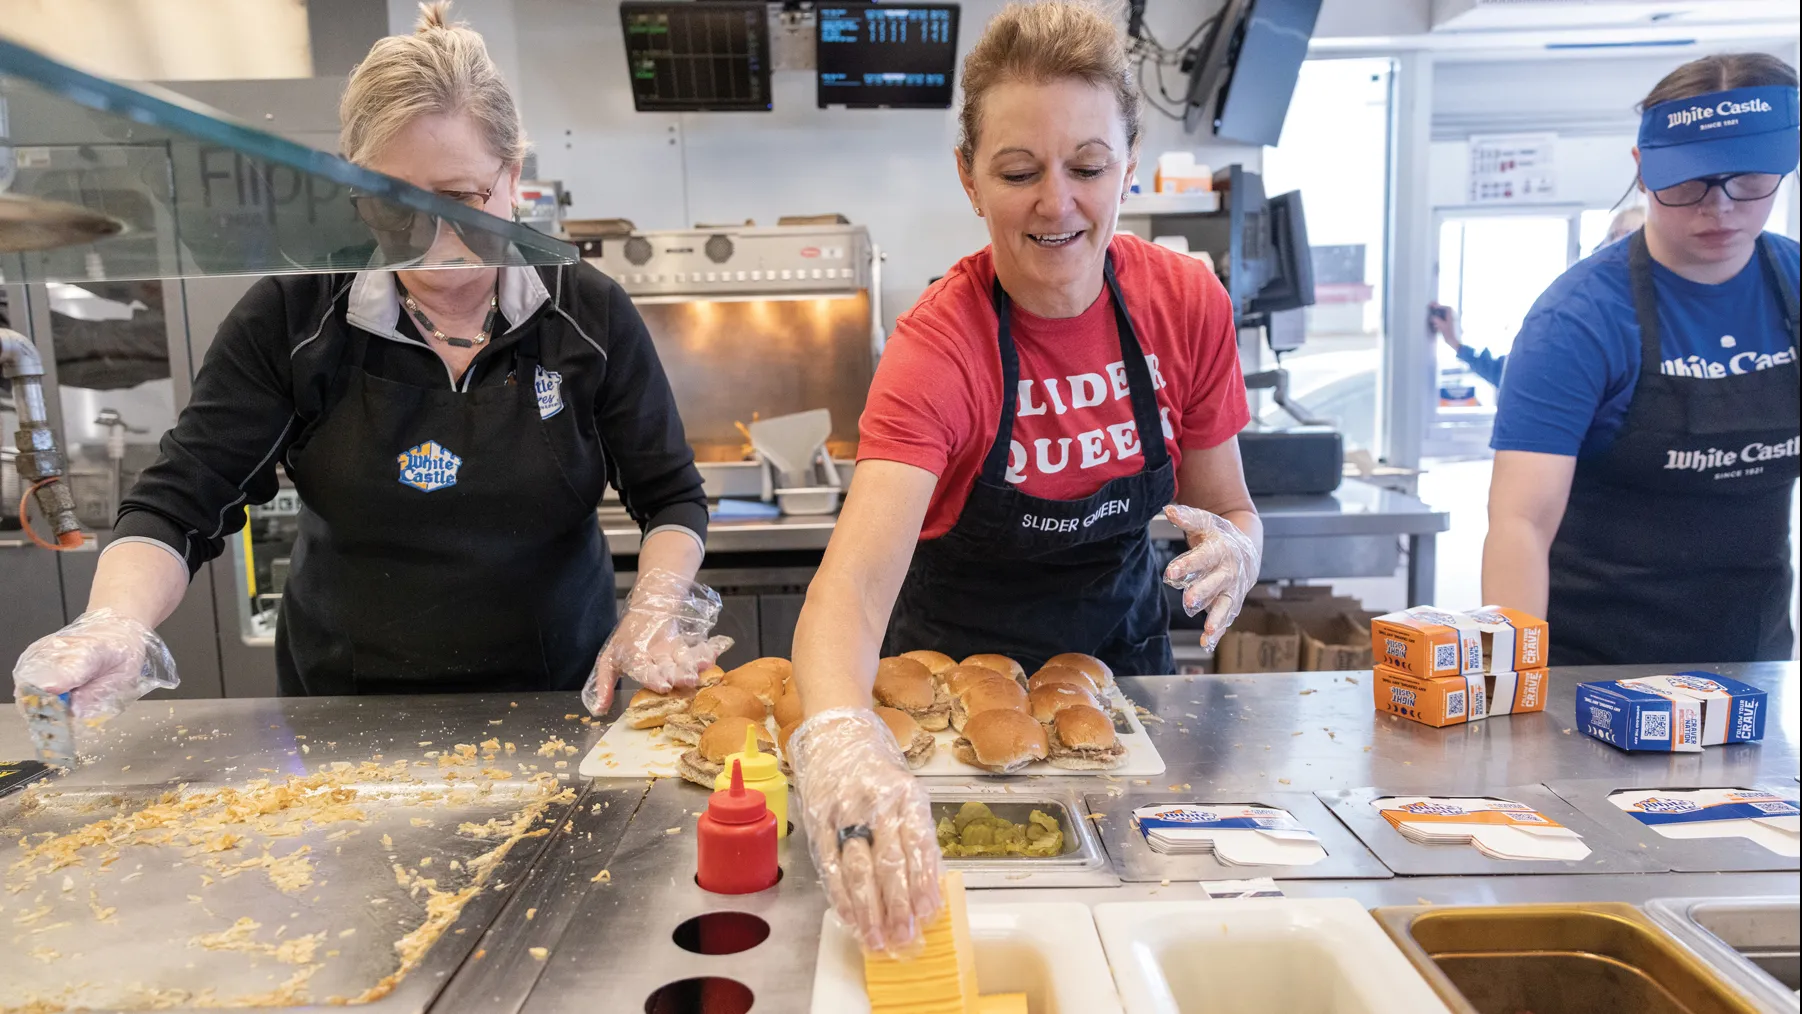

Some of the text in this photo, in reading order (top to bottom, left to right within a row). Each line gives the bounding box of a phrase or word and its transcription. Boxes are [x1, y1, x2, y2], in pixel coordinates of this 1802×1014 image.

[1667, 106, 1713, 129] White
[1700, 121, 1722, 131] SINCE
[199, 147, 342, 224] Flipp
[535, 379, 555, 393] tle
[1017, 353, 1167, 417] LIDER
[404, 453, 455, 471] White
[1664, 435, 1801, 472] White Castl
[400, 469, 456, 485] Castle
[1714, 469, 1743, 480] SINCE
[1022, 498, 1131, 532] SLIDER QUEEN
[1384, 638, 1408, 651] Castle
[1386, 646, 1407, 658] NIGHT
[1527, 628, 1537, 664] CRAVE
[1389, 686, 1417, 700] Castle
[1525, 672, 1538, 707] CRAVE
[1391, 695, 1415, 708] NIGHT
[1741, 699, 1754, 740] CRAVE
